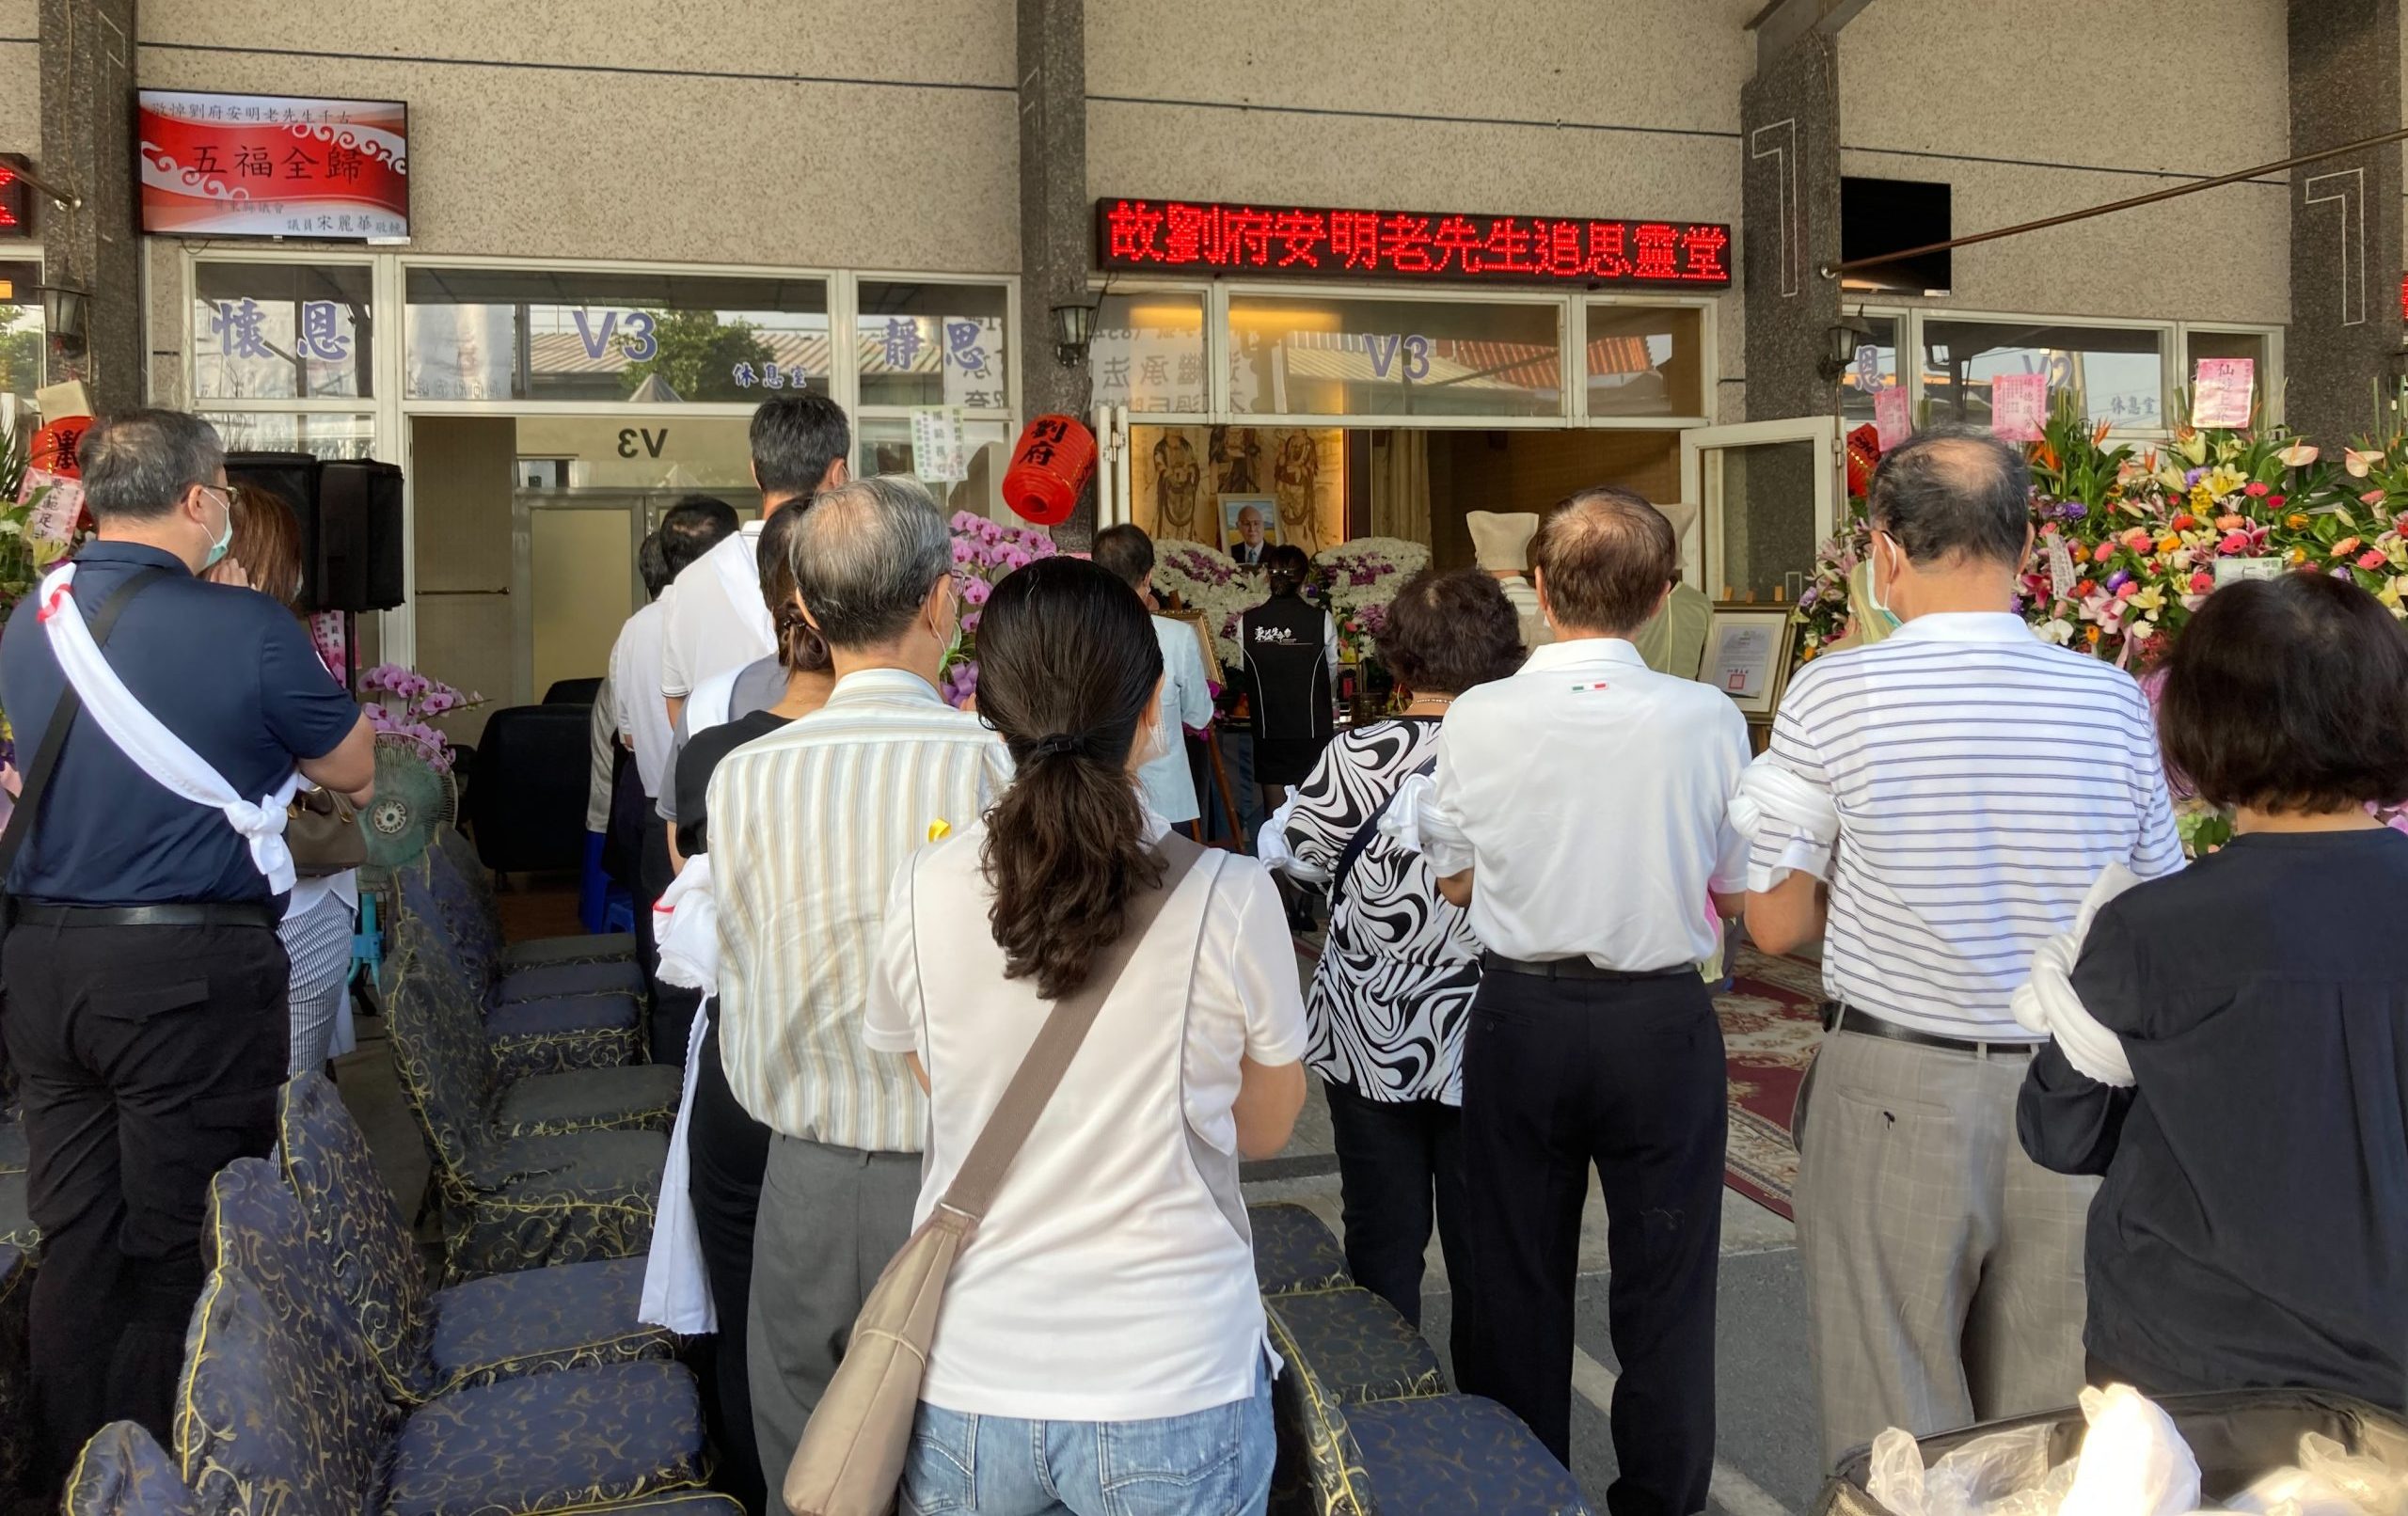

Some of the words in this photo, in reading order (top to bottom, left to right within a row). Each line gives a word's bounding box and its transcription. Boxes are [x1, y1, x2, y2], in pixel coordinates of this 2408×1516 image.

[188, 144, 364, 185] 五福全歸
[1108, 200, 1727, 279] 故劉府安明老先生追思靈堂
[212, 298, 351, 362] 懷恩
[572, 310, 657, 362] V3
[878, 318, 986, 371] 靜思
[733, 361, 808, 388] 休息室
[1362, 334, 1430, 380] V3
[2110, 396, 2156, 416] 休息室
